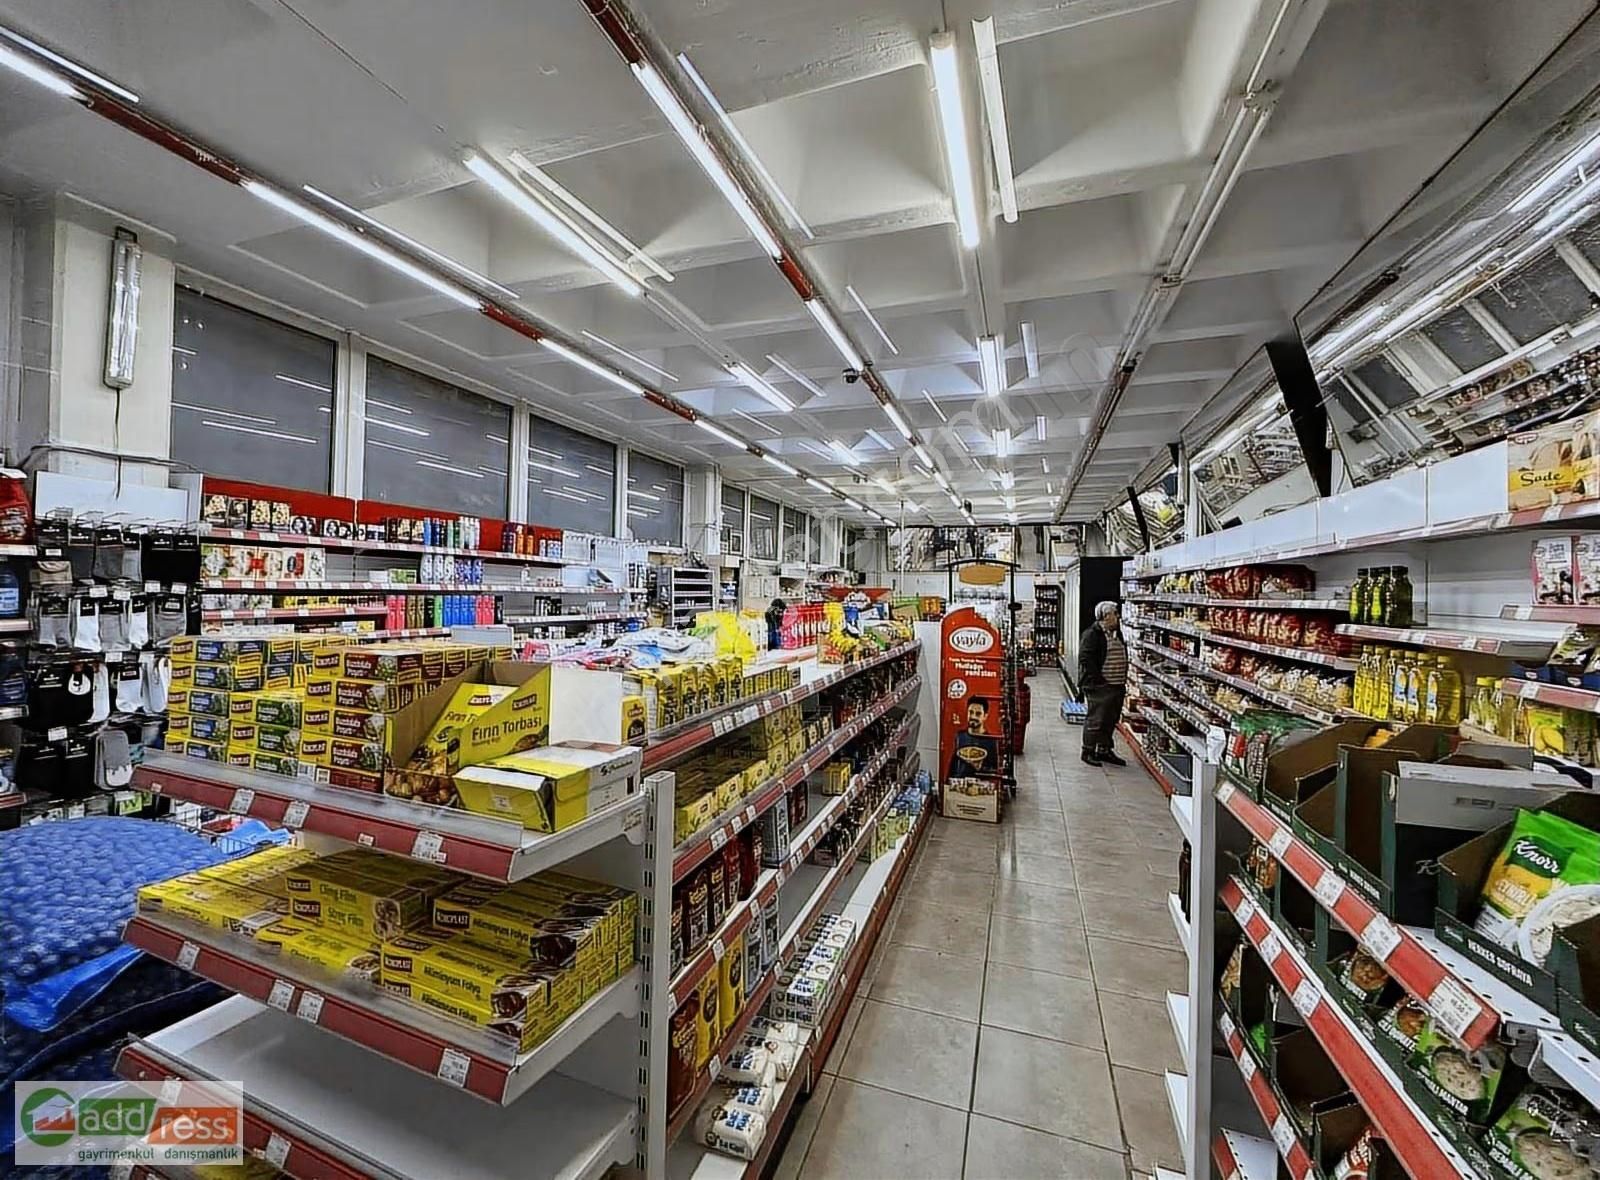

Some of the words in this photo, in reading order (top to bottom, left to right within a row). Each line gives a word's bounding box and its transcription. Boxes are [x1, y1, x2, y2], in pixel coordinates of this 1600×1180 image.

[1521, 472, 1564, 487] Sade
[472, 724, 499, 740] Fırın
[502, 716, 542, 734] Torbası
[1513, 839, 1561, 874] Knorr
